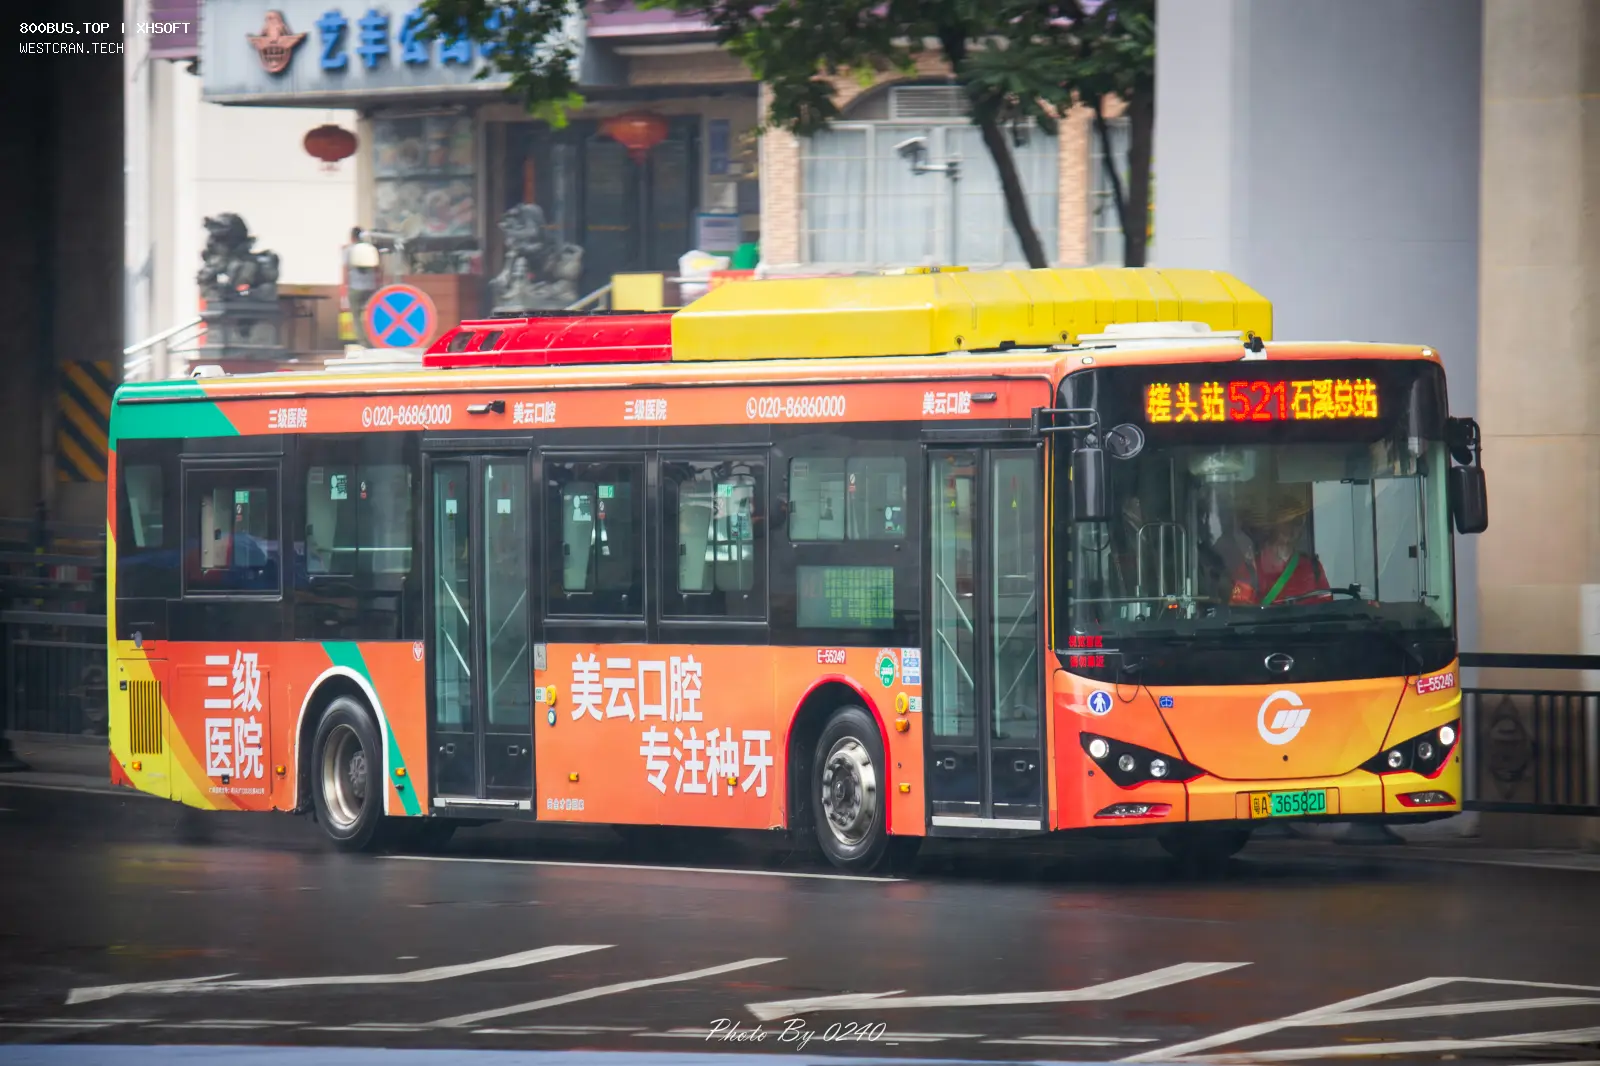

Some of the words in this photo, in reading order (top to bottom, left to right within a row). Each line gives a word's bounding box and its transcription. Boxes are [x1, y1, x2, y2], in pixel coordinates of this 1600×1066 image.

[623, 399, 668, 421] 三级医院
[758, 395, 846, 418] 020-86860000
[922, 391, 972, 415] 美云口腔
[1229, 379, 1288, 422] 521
[1290, 377, 1378, 419] 石溪总站
[267, 407, 308, 429] 三级医院
[373, 404, 452, 427] 020-86860000
[512, 402, 557, 425] 美云口腔
[817, 649, 846, 664] E-55249
[204, 648, 263, 713] 三级
[570, 652, 704, 723] 美云口腔
[1416, 672, 1455, 694] E-55249
[205, 715, 264, 780] 医院
[639, 724, 774, 798] 专注种牙
